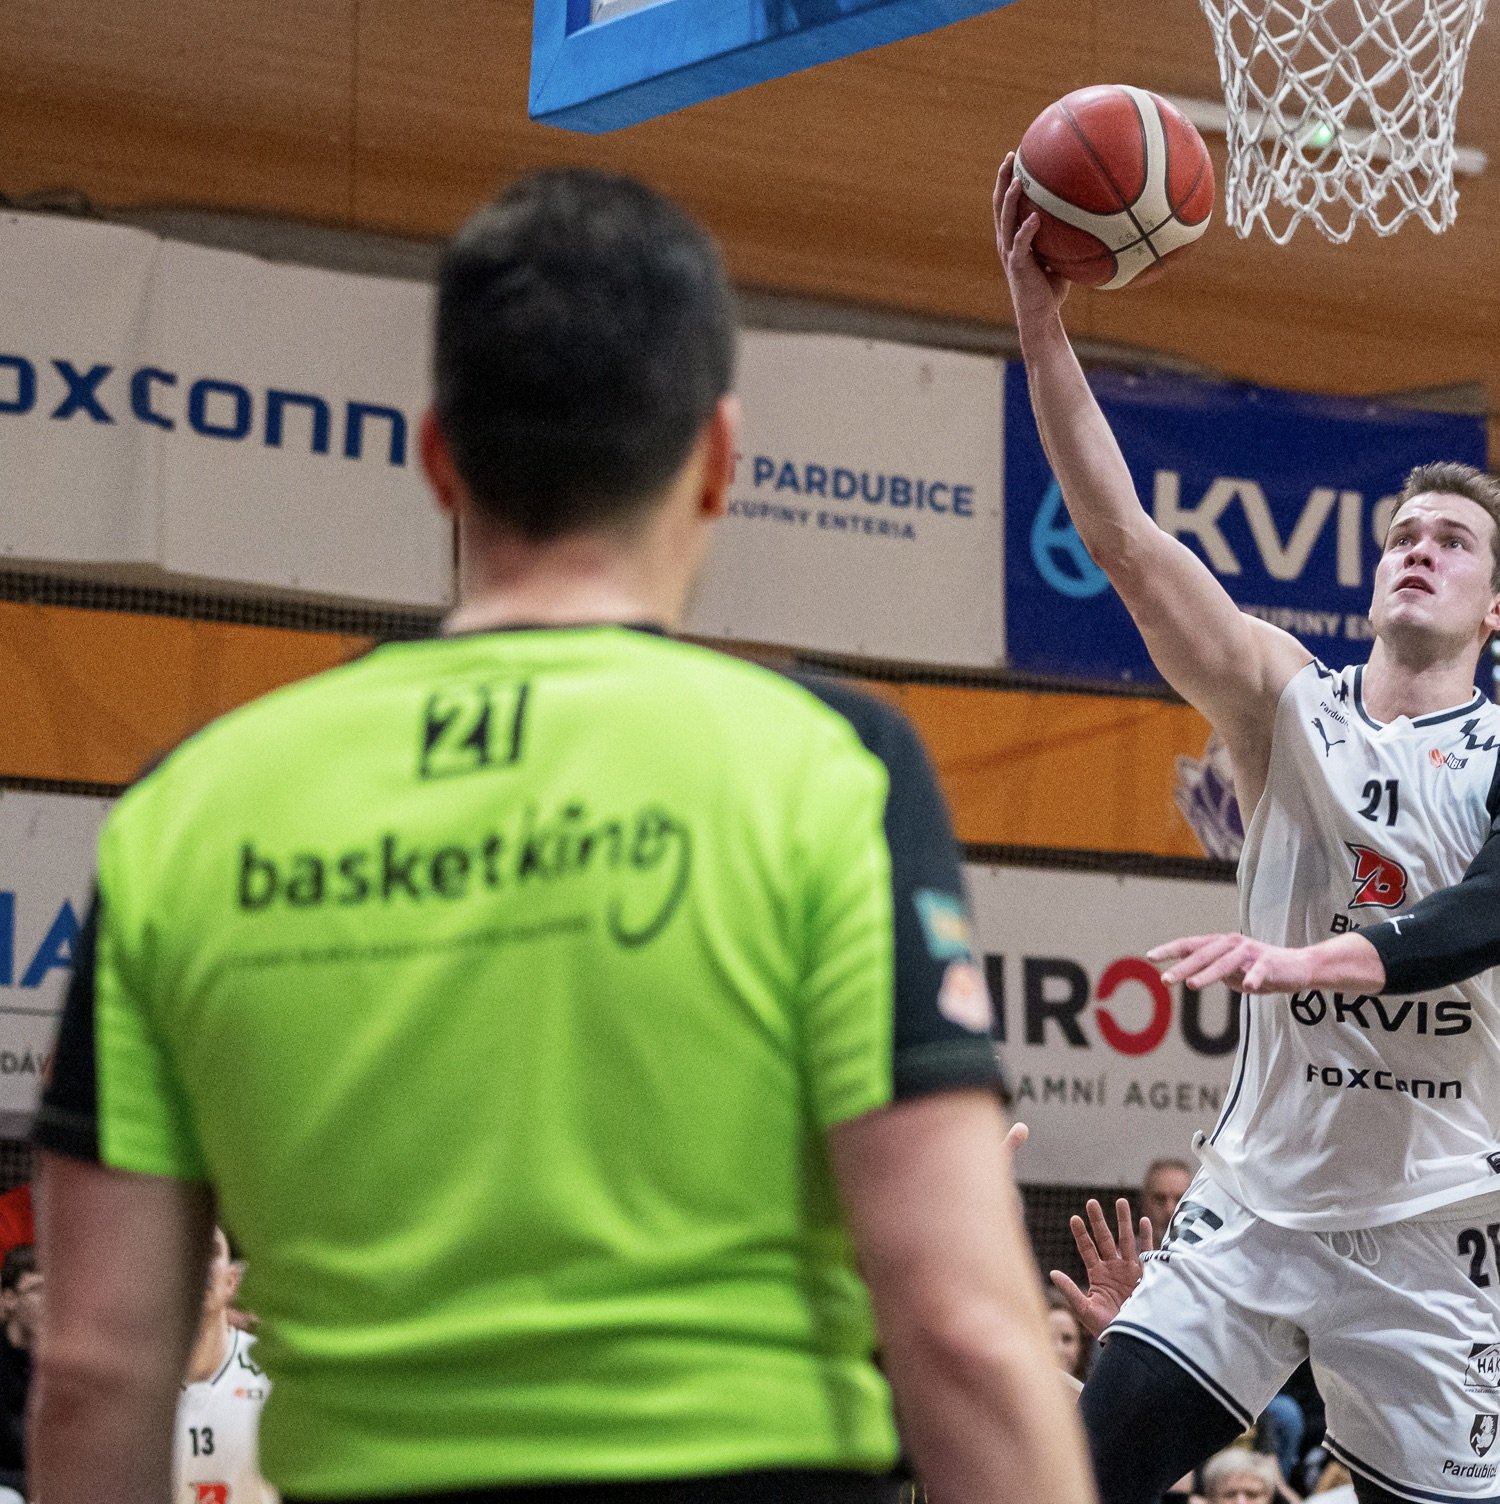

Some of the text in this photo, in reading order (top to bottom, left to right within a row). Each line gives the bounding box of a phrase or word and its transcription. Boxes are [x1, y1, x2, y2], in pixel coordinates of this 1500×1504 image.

[752, 455, 975, 519] PARDUBICE
[1358, 779, 1400, 827] 21
[1334, 992, 1473, 1037] KVIS
[1015, 1072, 1223, 1114] AMNÍ AGEN
[188, 1427, 215, 1457] 13
